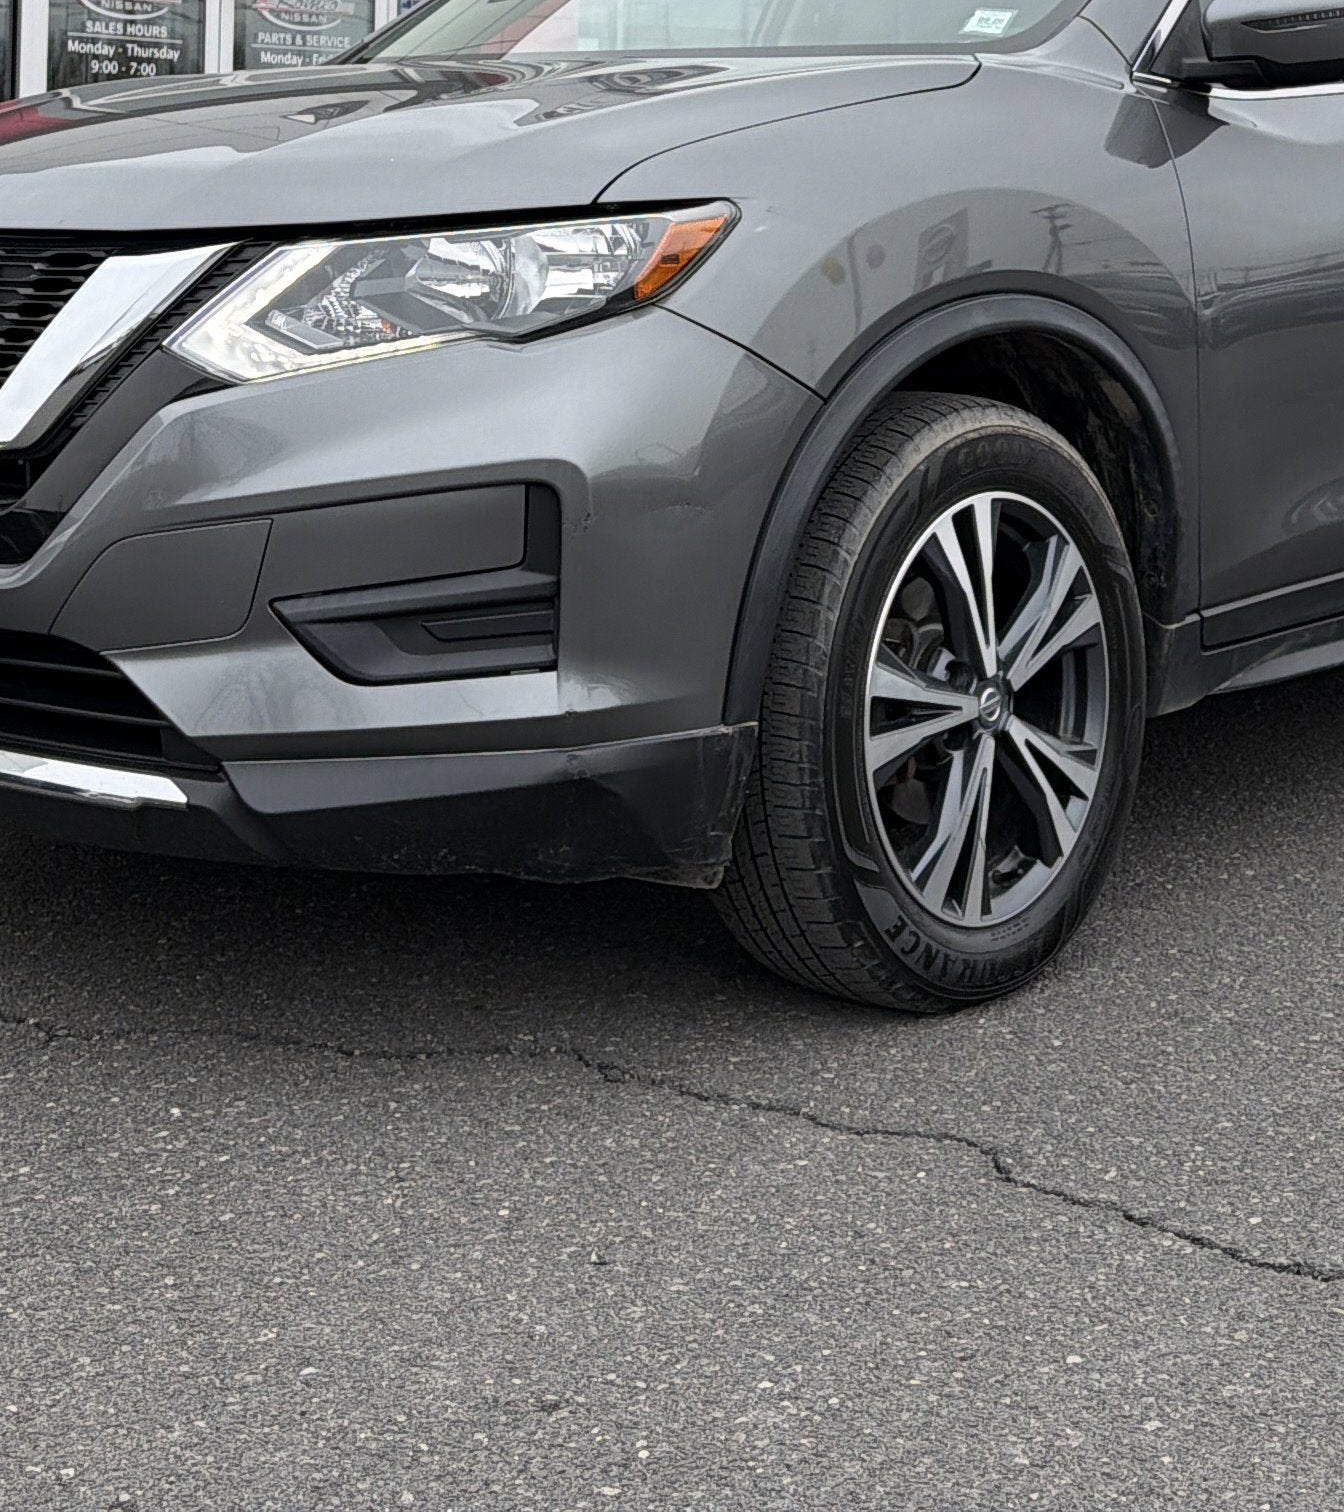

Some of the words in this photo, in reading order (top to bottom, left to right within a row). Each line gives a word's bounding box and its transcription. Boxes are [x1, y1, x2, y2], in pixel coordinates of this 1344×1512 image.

[101, 0, 152, 12] NISSAN
[280, 11, 328, 24] NISSAN
[85, 20, 124, 35] SALES
[126, 22, 168, 38] HOURS
[258, 31, 292, 45] PARTS
[295, 34, 303, 45] &
[306, 35, 351, 48] SERVICE
[67, 39, 116, 58] Monday
[126, 43, 181, 63] Thursday
[260, 50, 304, 67] Monday
[91, 60, 119, 75] 9:00
[129, 62, 156, 77] 7:00
